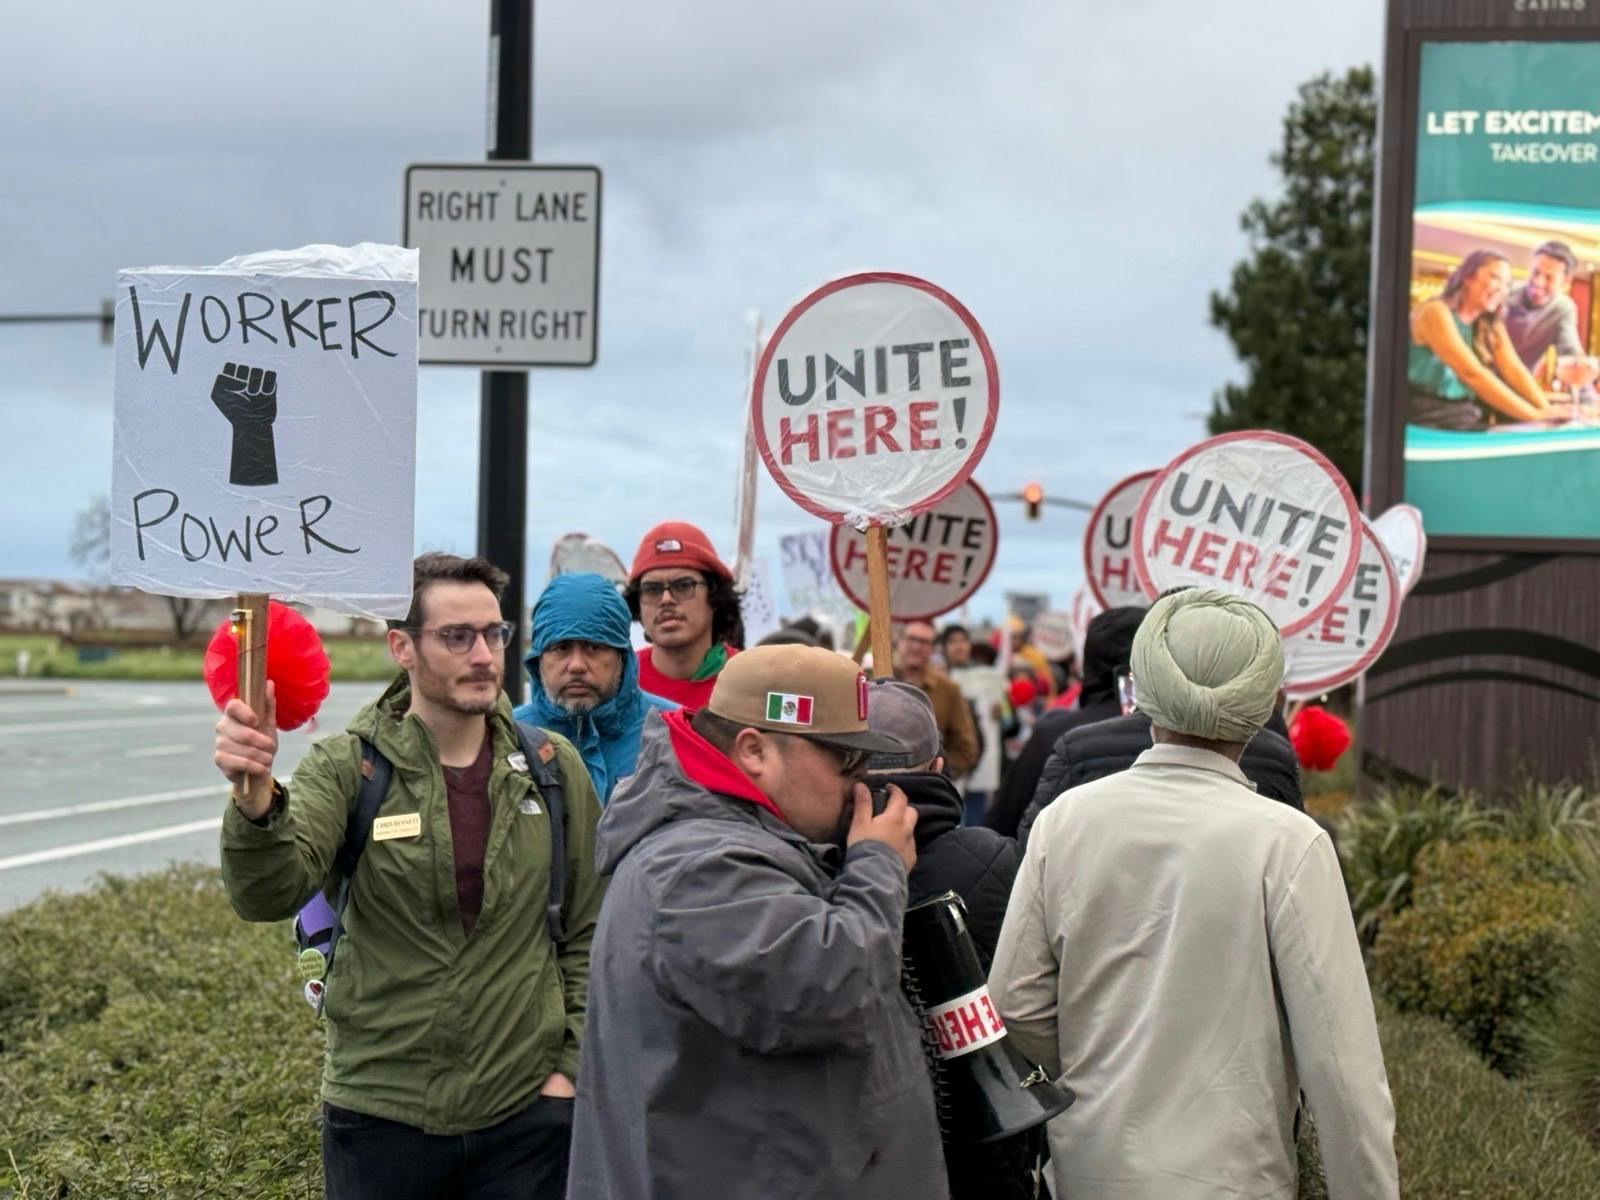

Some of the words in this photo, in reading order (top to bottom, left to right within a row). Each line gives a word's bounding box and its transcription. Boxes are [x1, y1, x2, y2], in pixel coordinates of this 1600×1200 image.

[1514, 0, 1586, 11] CASINO
[1426, 111, 1480, 135] LET
[1490, 142, 1598, 163] TAKEOVER
[418, 191, 499, 220] RIGHT
[516, 193, 587, 222] LANE
[451, 248, 554, 284] MUST
[129, 285, 398, 375] WORKER
[418, 309, 490, 339] TURN
[500, 310, 588, 340] RIGHT
[777, 338, 971, 406] UNITE
[779, 397, 968, 465] HERE!
[1169, 471, 1346, 560] UNITE
[1151, 518, 1325, 608] HERE!
